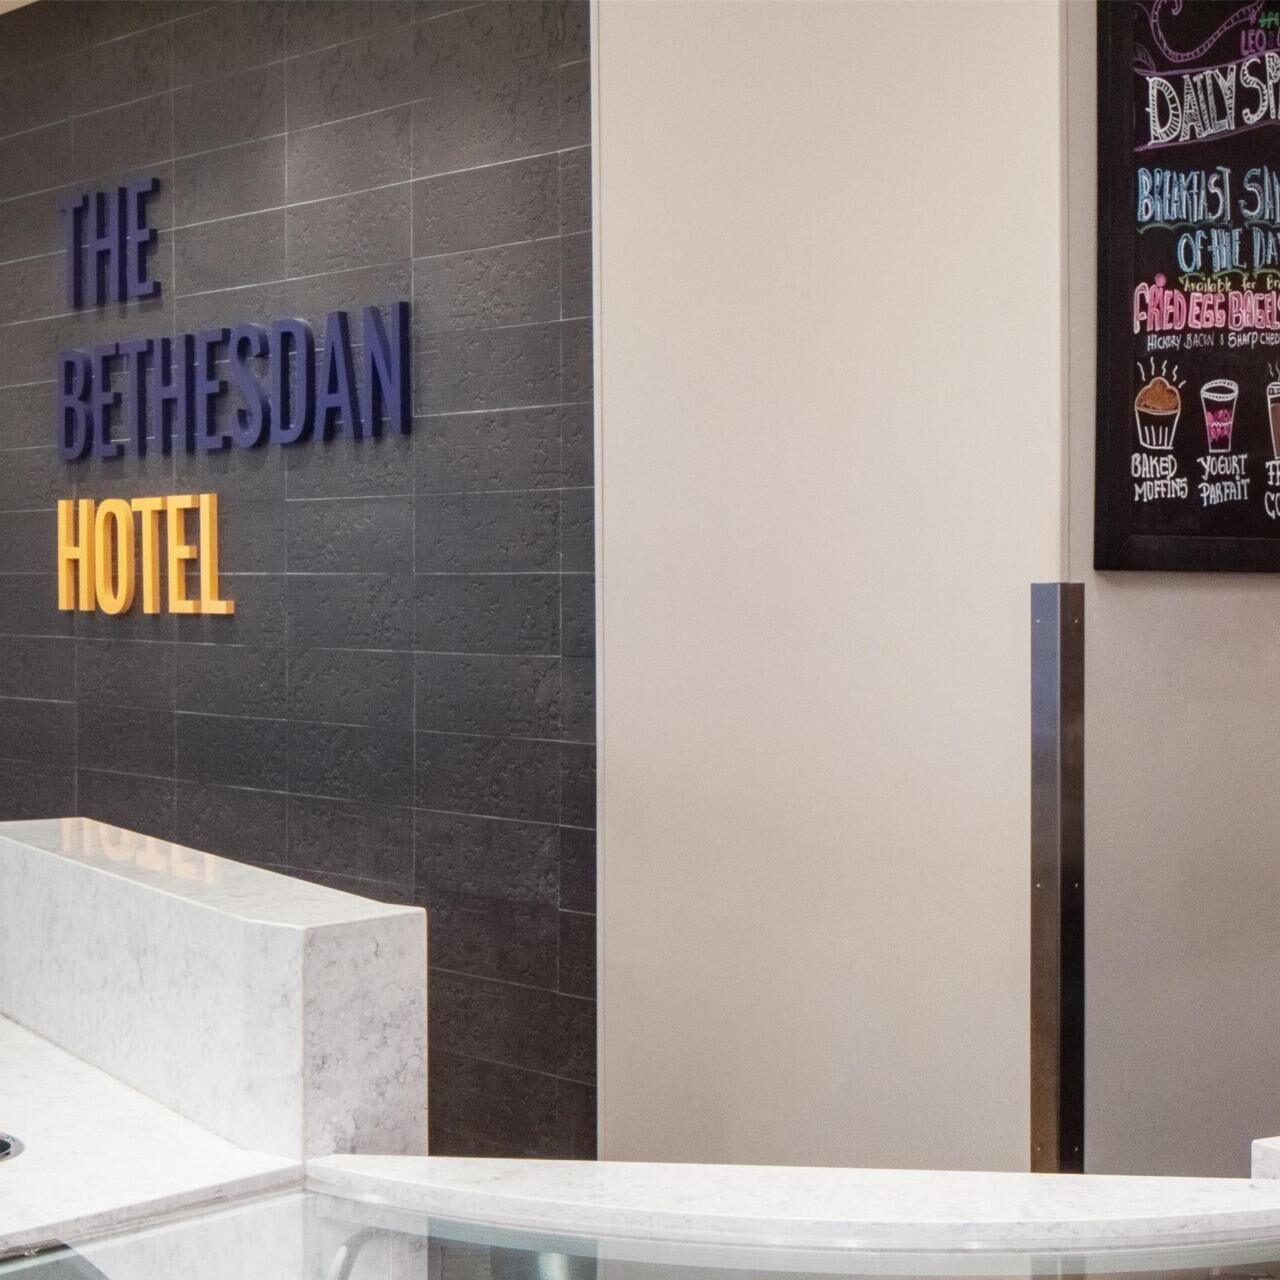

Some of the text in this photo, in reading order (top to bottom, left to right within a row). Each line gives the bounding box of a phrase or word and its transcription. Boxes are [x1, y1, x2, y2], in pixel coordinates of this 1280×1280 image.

[1146, 65, 1236, 146] DAILY
[58, 177, 161, 310] THE
[58, 301, 411, 462] BETHESDAN
[1131, 453, 1177, 478] BAKED
[1197, 454, 1248, 477] YOGURT
[1198, 478, 1250, 507] PARFAIT
[58, 493, 234, 615] HOTEL
